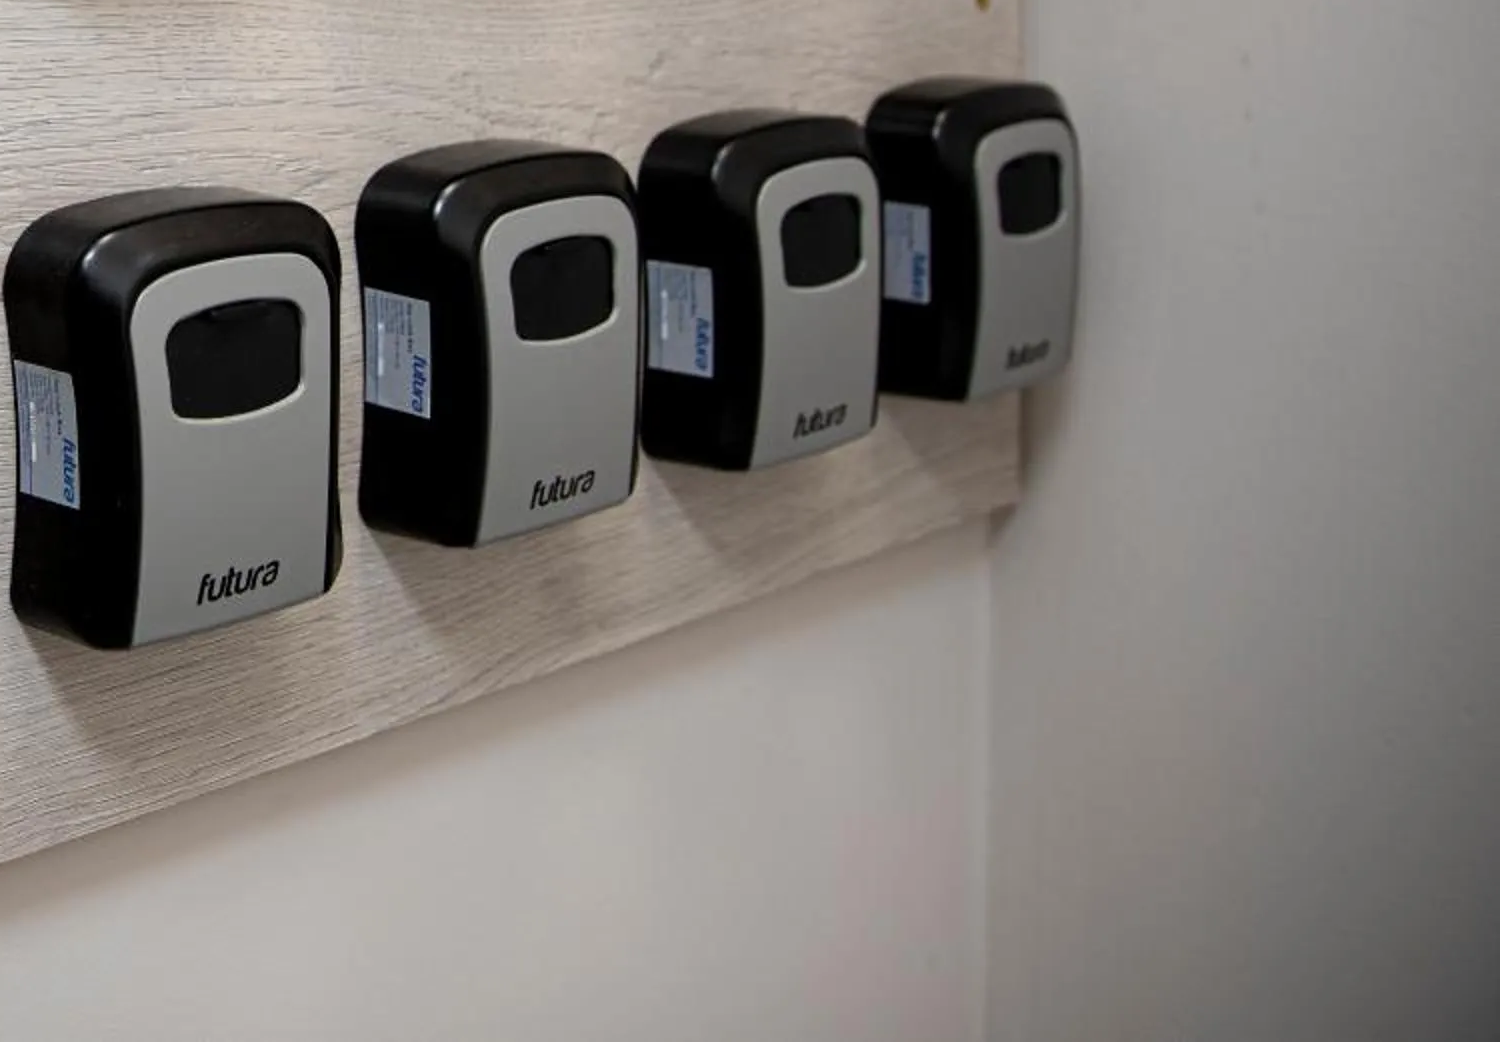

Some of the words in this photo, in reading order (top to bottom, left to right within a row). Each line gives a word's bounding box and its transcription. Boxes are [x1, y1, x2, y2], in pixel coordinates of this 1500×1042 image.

[411, 353, 428, 412] futura
[792, 403, 848, 439] futura
[62, 438, 77, 504] futura
[528, 469, 597, 511] futura
[196, 560, 280, 606] futura
